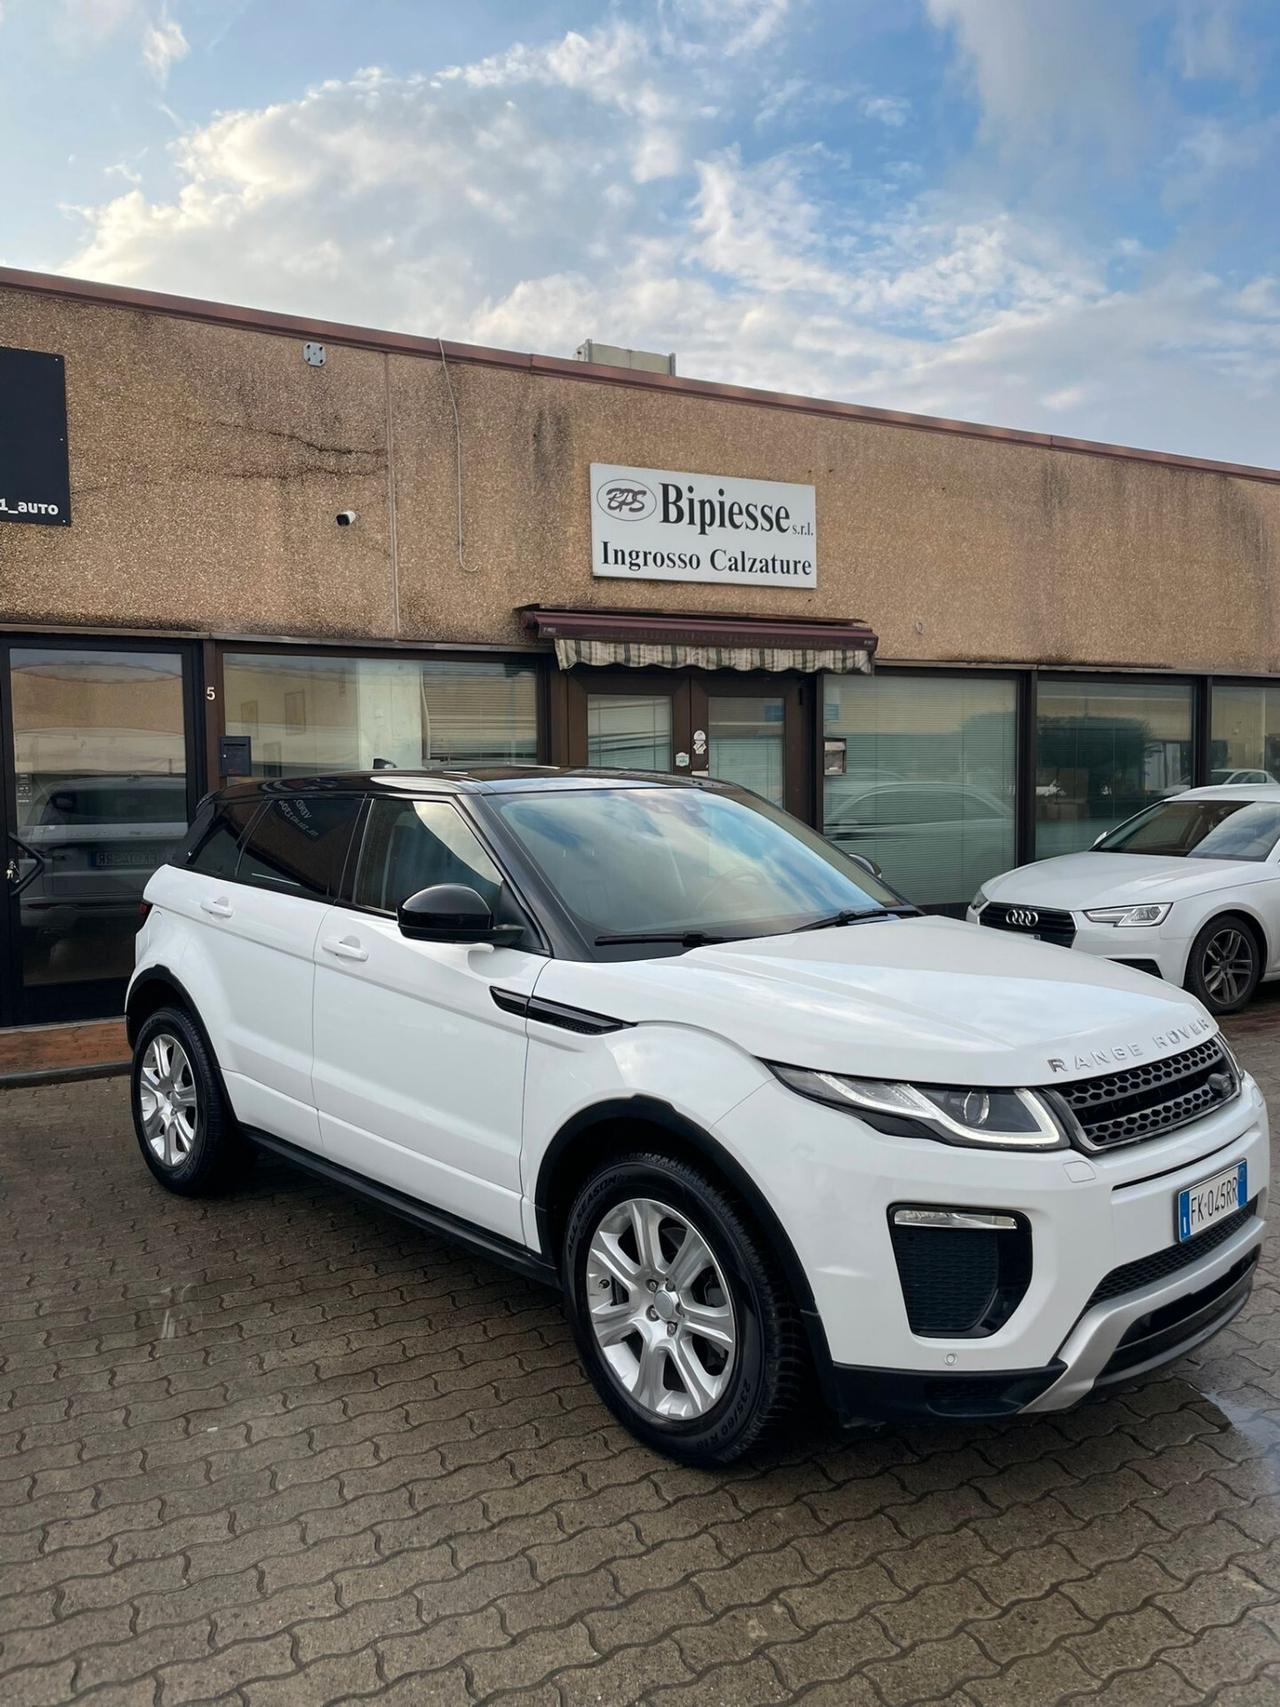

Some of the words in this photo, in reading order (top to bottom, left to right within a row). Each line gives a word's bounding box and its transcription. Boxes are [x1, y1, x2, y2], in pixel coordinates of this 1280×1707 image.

[658, 482, 791, 535] Bipiesse
[791, 522, 814, 536] s.r.l.
[601, 541, 701, 571] Ingrosso
[709, 548, 812, 575] Calzature
[206, 686, 216, 701] 5
[1047, 1044, 1143, 1072] RANGE
[1152, 1018, 1210, 1048] ROVER
